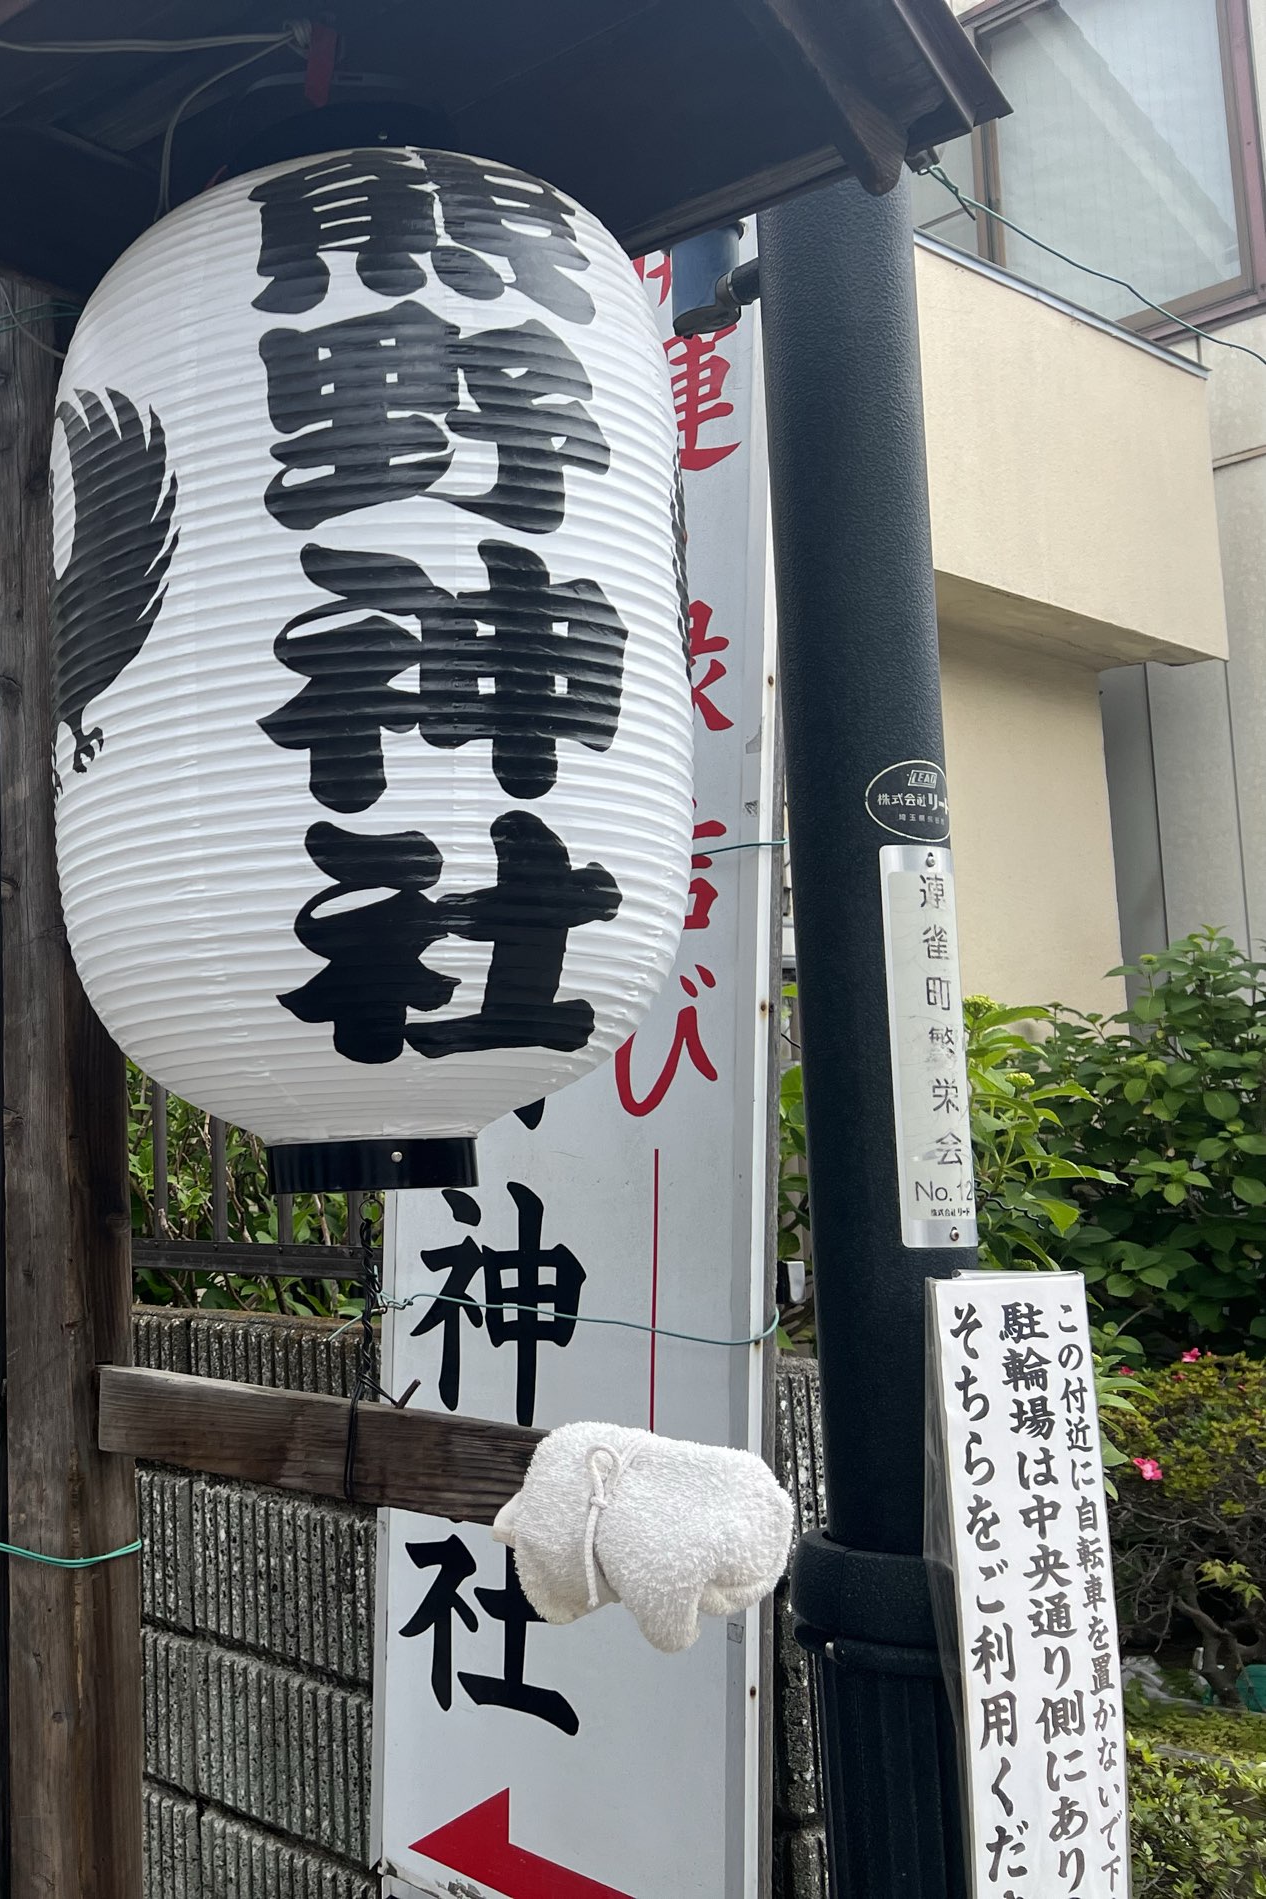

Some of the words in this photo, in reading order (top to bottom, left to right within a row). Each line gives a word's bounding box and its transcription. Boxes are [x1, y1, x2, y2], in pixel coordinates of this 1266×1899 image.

[256, 148, 627, 1063] 熊野神社
[950, 1301, 1030, 1899] そちらをご利用くだ
[1000, 1301, 1090, 1899] 駐輪場は中央通り側にあり
[1056, 1304, 1125, 1899] この付近に自転車を置かないで下
